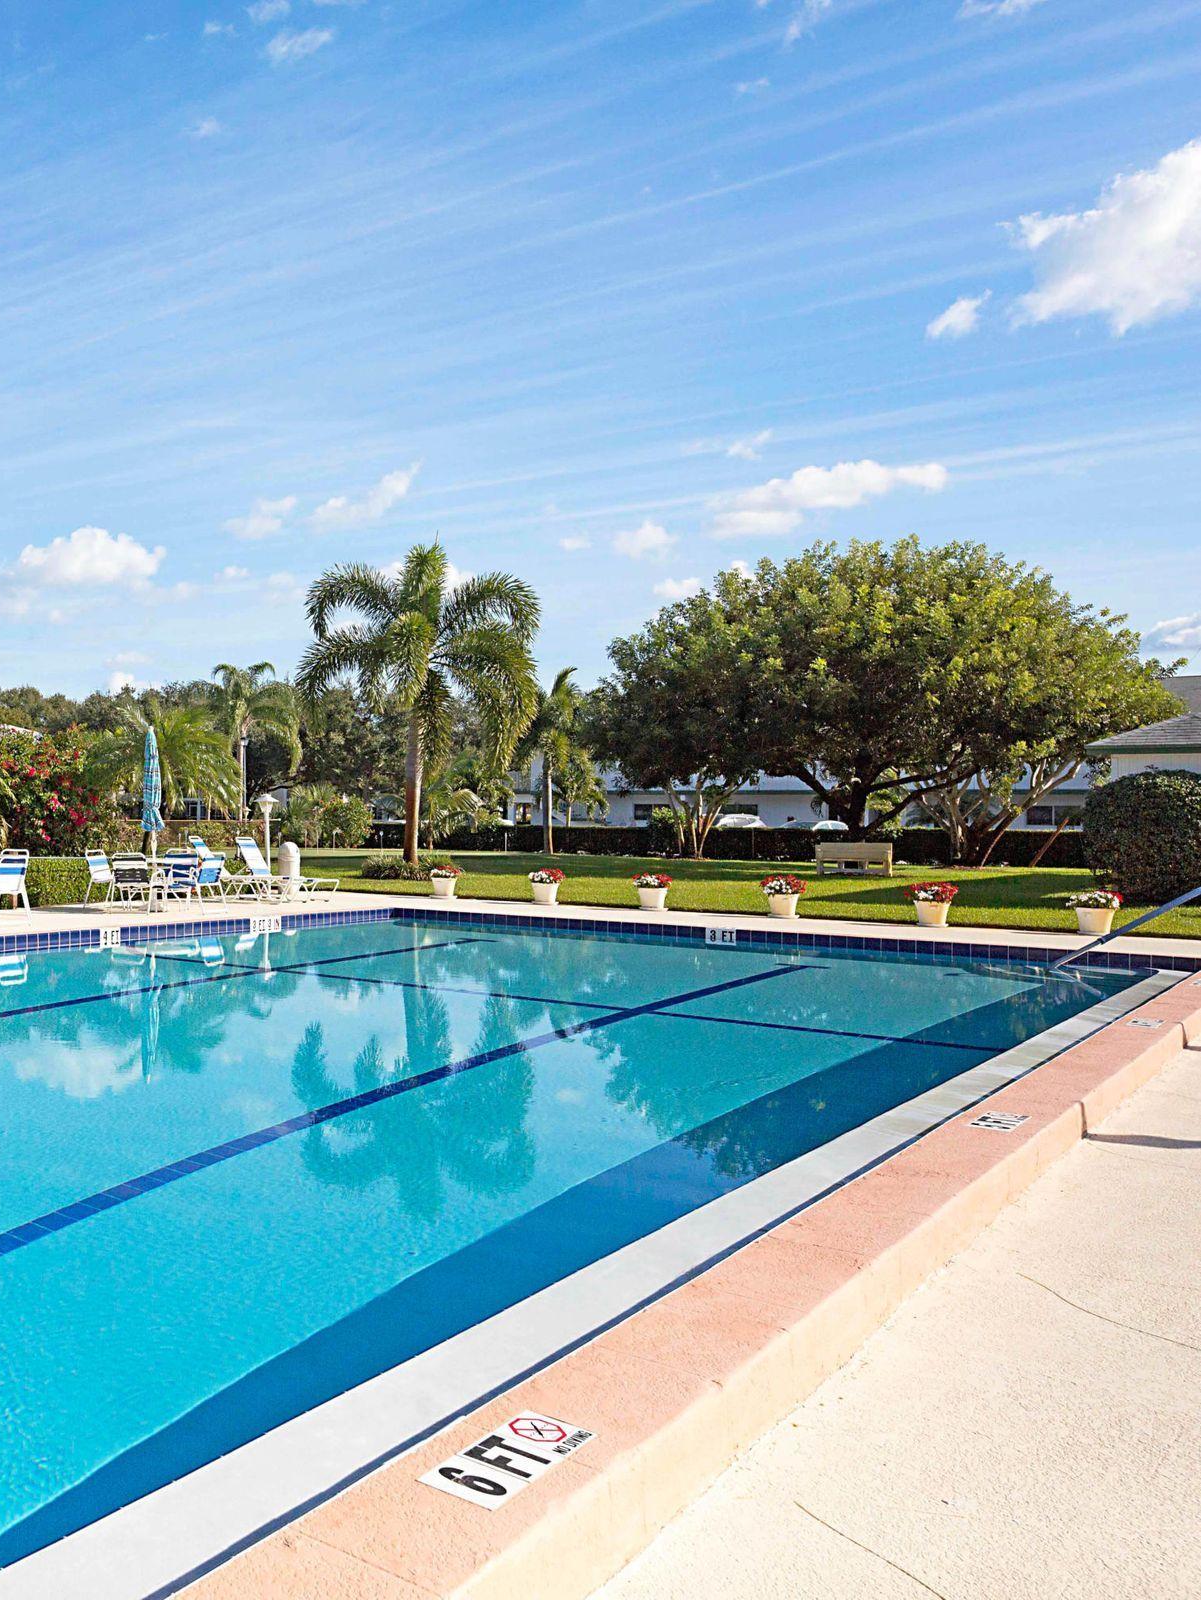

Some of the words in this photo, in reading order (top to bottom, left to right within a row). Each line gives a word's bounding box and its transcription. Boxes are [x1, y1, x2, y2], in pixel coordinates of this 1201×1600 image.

[103, 930, 108, 945] 4
[110, 930, 120, 945] FT
[710, 929, 716, 942] 3
[721, 930, 734, 943] FT
[552, 1445, 571, 1456] NO
[562, 1430, 593, 1448] DIVING
[463, 1434, 552, 1479] FT
[438, 1467, 508, 1496] 6
